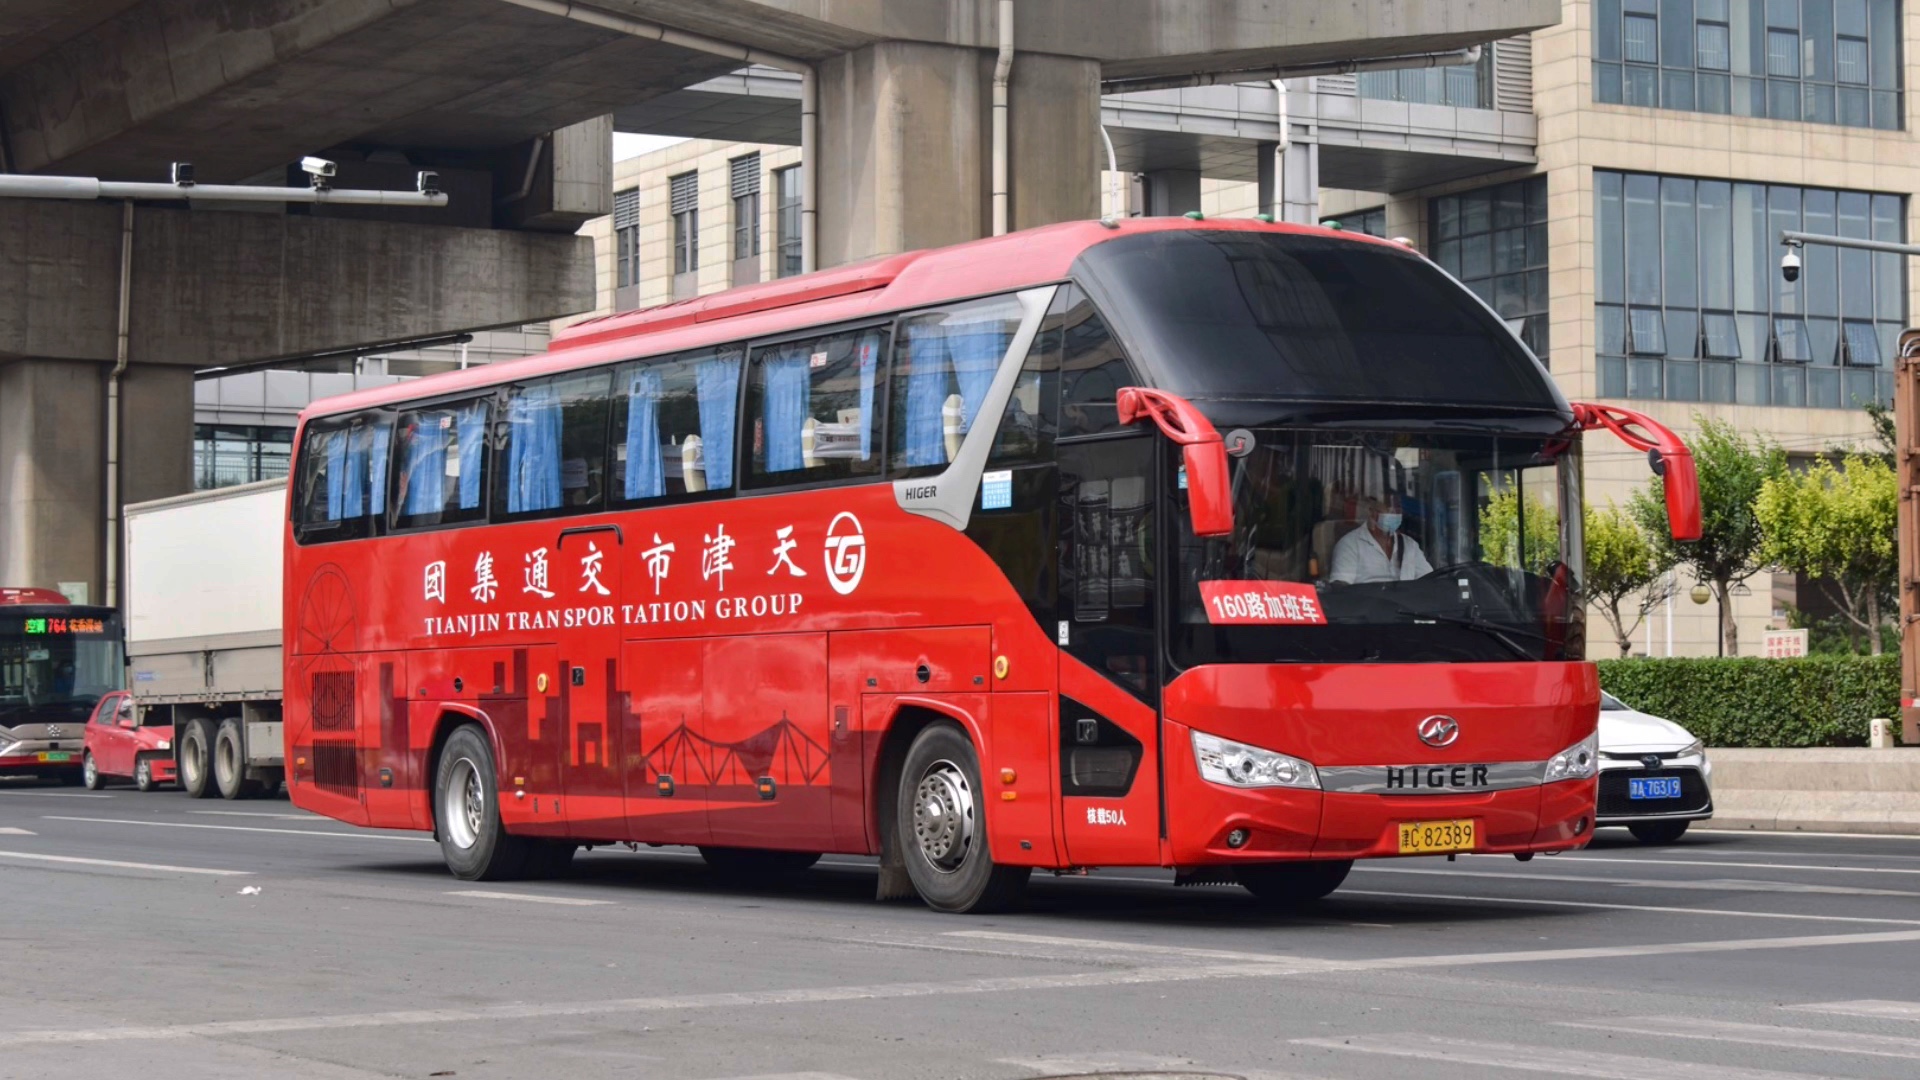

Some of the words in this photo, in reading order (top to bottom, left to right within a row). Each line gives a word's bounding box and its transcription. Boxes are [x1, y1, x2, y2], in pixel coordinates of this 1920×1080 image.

[906, 485, 937, 500] HIGER
[424, 613, 500, 637] TIANJIN
[716, 592, 803, 619] GROUP
[1212, 591, 1321, 624] 160路加班车
[48, 618, 67, 634] 764
[1387, 764, 1489, 789] HIGER
